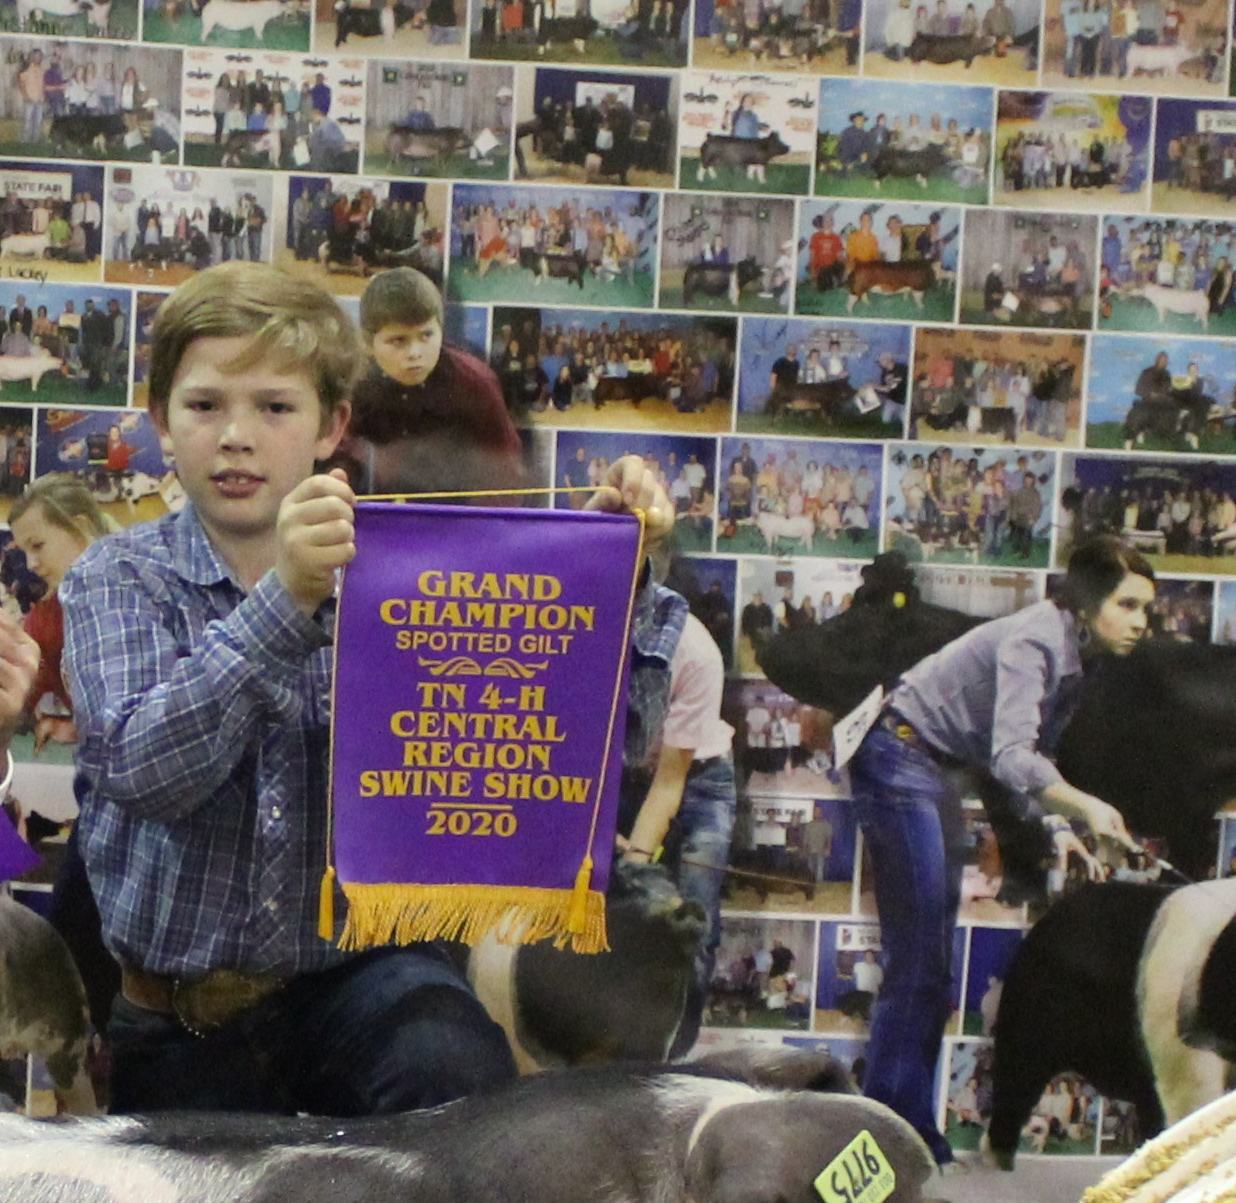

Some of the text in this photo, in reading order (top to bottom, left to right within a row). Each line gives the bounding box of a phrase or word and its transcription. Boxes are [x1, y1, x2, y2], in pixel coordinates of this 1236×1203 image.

[4, 180, 36, 192] STATE
[417, 570, 562, 600] GRAND
[379, 599, 595, 631] CHAMPION
[396, 630, 573, 654] SPOTTED GILT
[417, 682, 546, 711] TN 4-H
[389, 710, 566, 742] CENTRAL
[402, 741, 552, 770] REGION
[359, 770, 592, 803] SWINE SHOW
[425, 810, 518, 837] 2020
